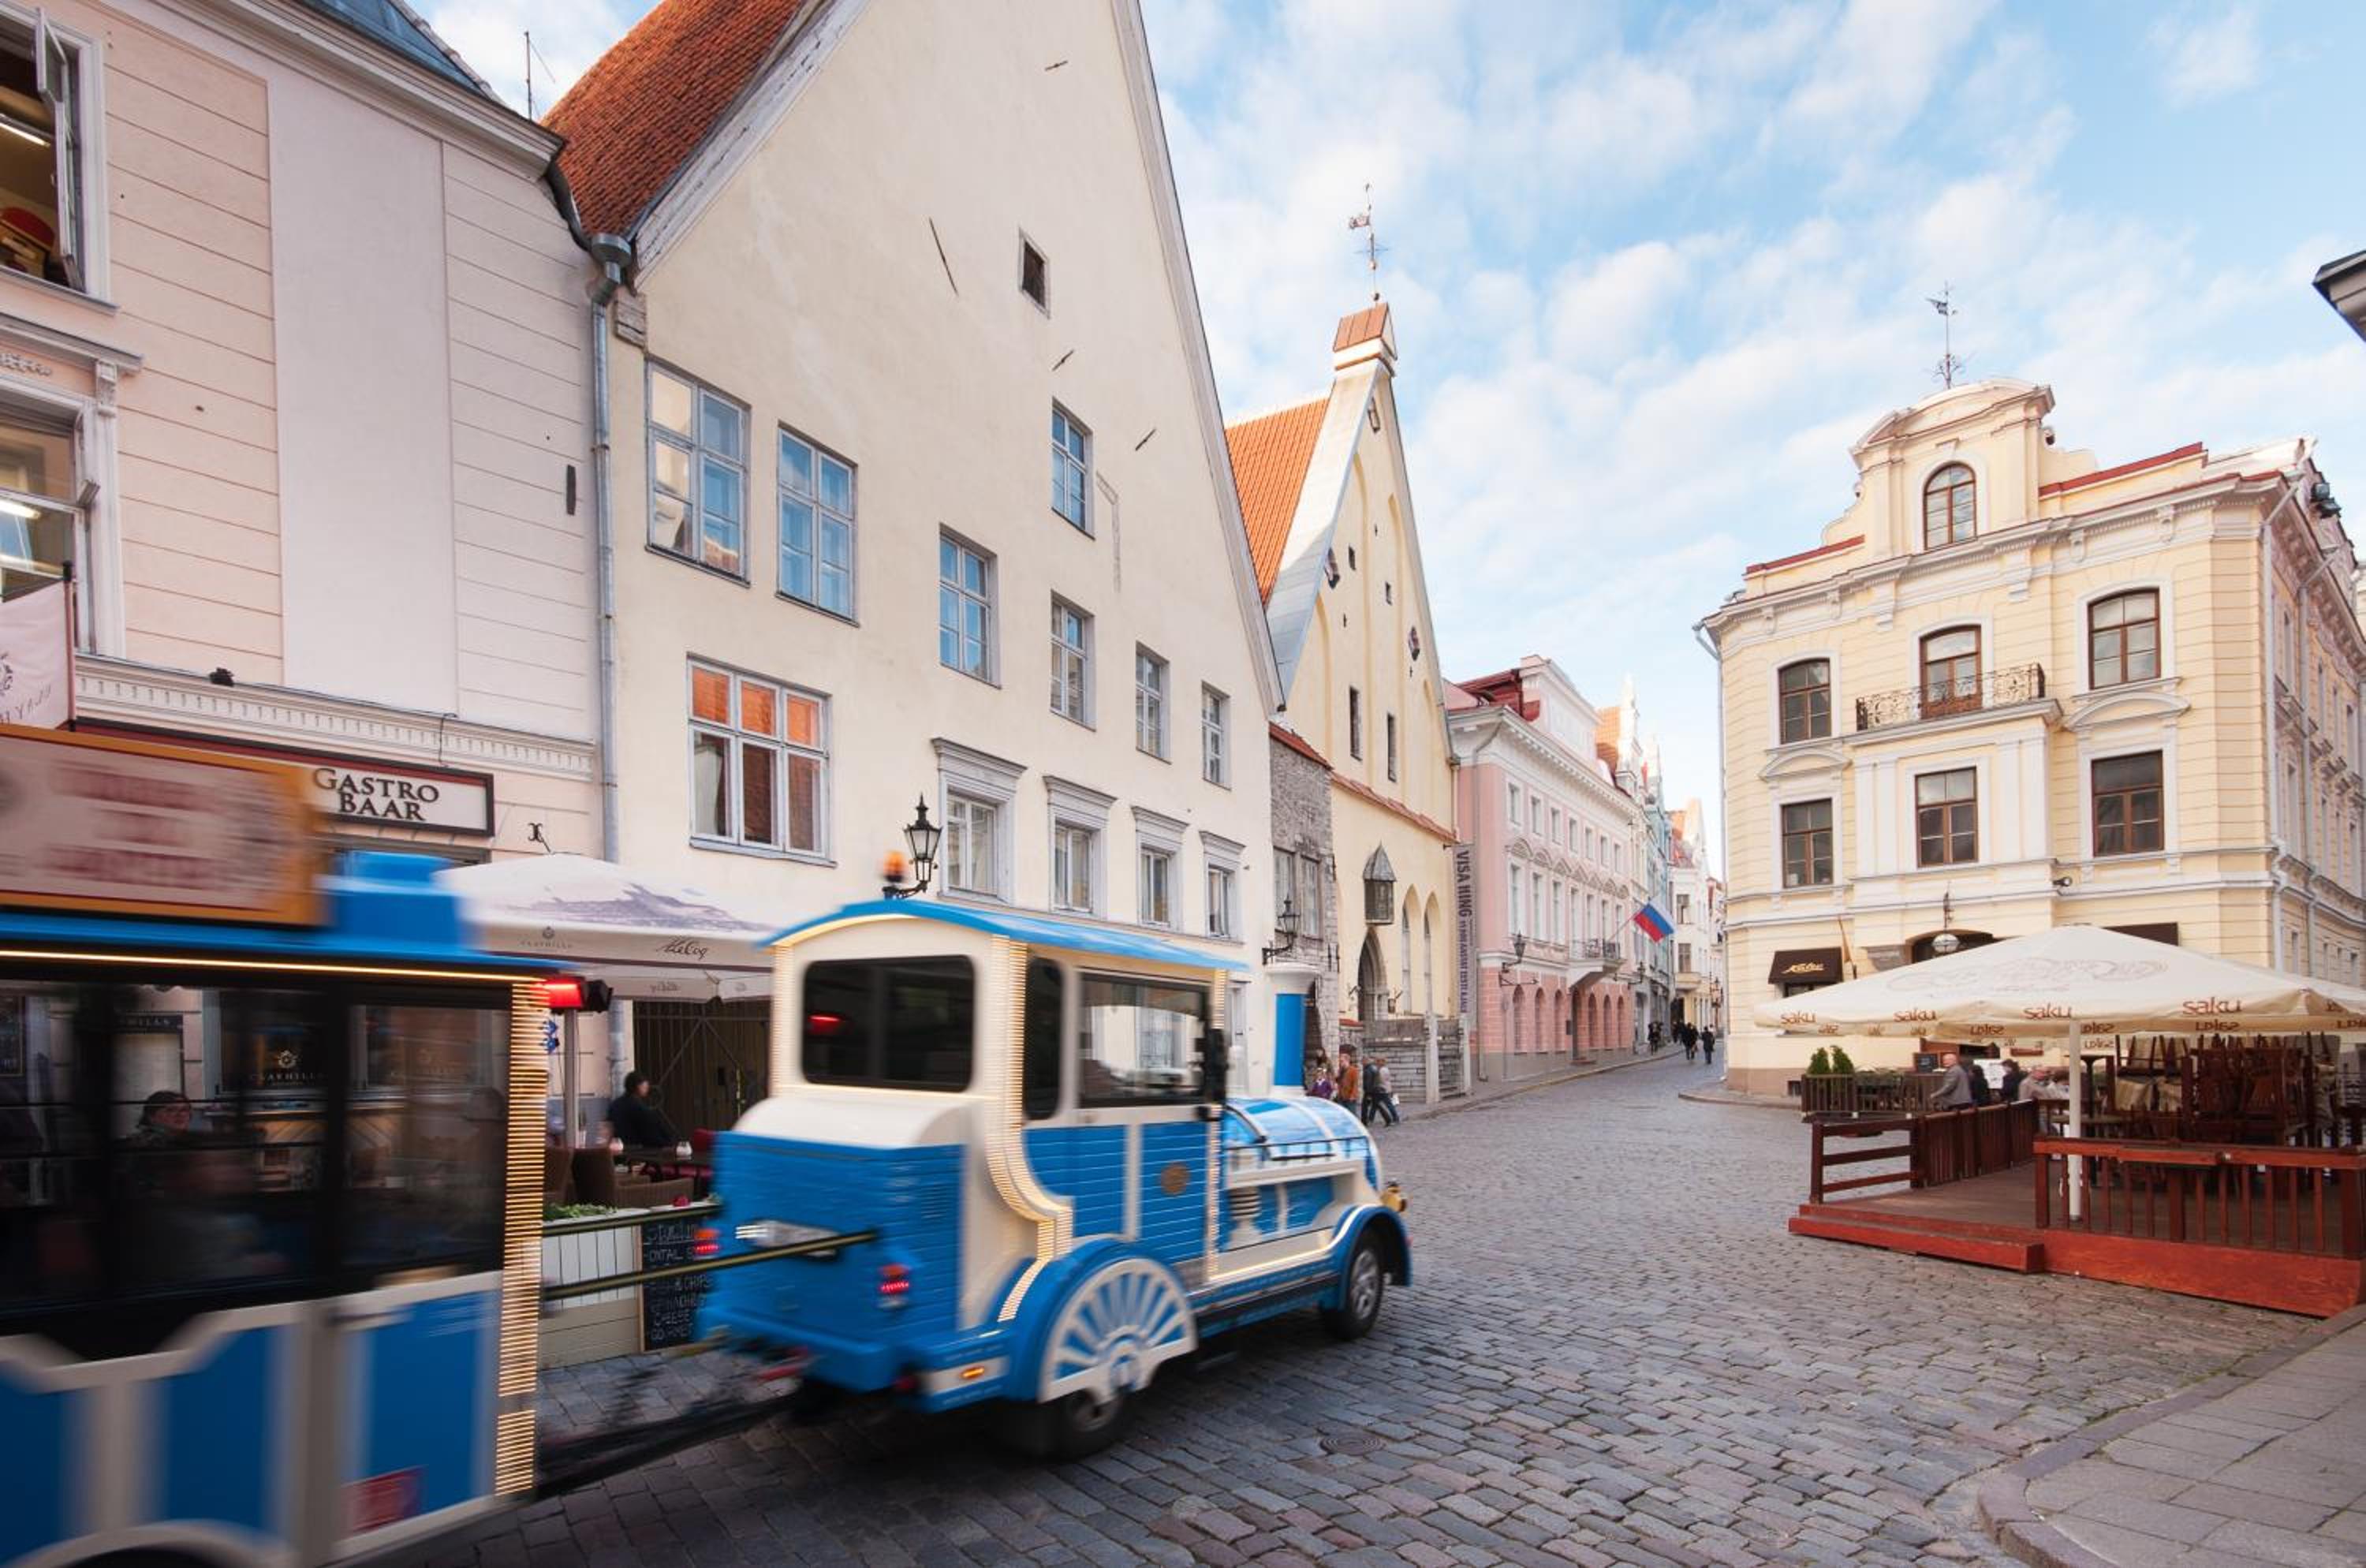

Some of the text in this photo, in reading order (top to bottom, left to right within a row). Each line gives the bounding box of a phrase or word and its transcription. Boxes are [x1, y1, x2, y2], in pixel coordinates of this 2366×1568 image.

[314, 767, 439, 803] GASTRO
[338, 790, 426, 821] BAAR
[1457, 850, 1471, 883] VISA
[1457, 884, 1472, 917] HING
[1780, 1010, 1817, 1025] saku
[1893, 1008, 1938, 1023] saku
[2024, 1003, 2072, 1020] saku
[2181, 997, 2241, 1014] saku
